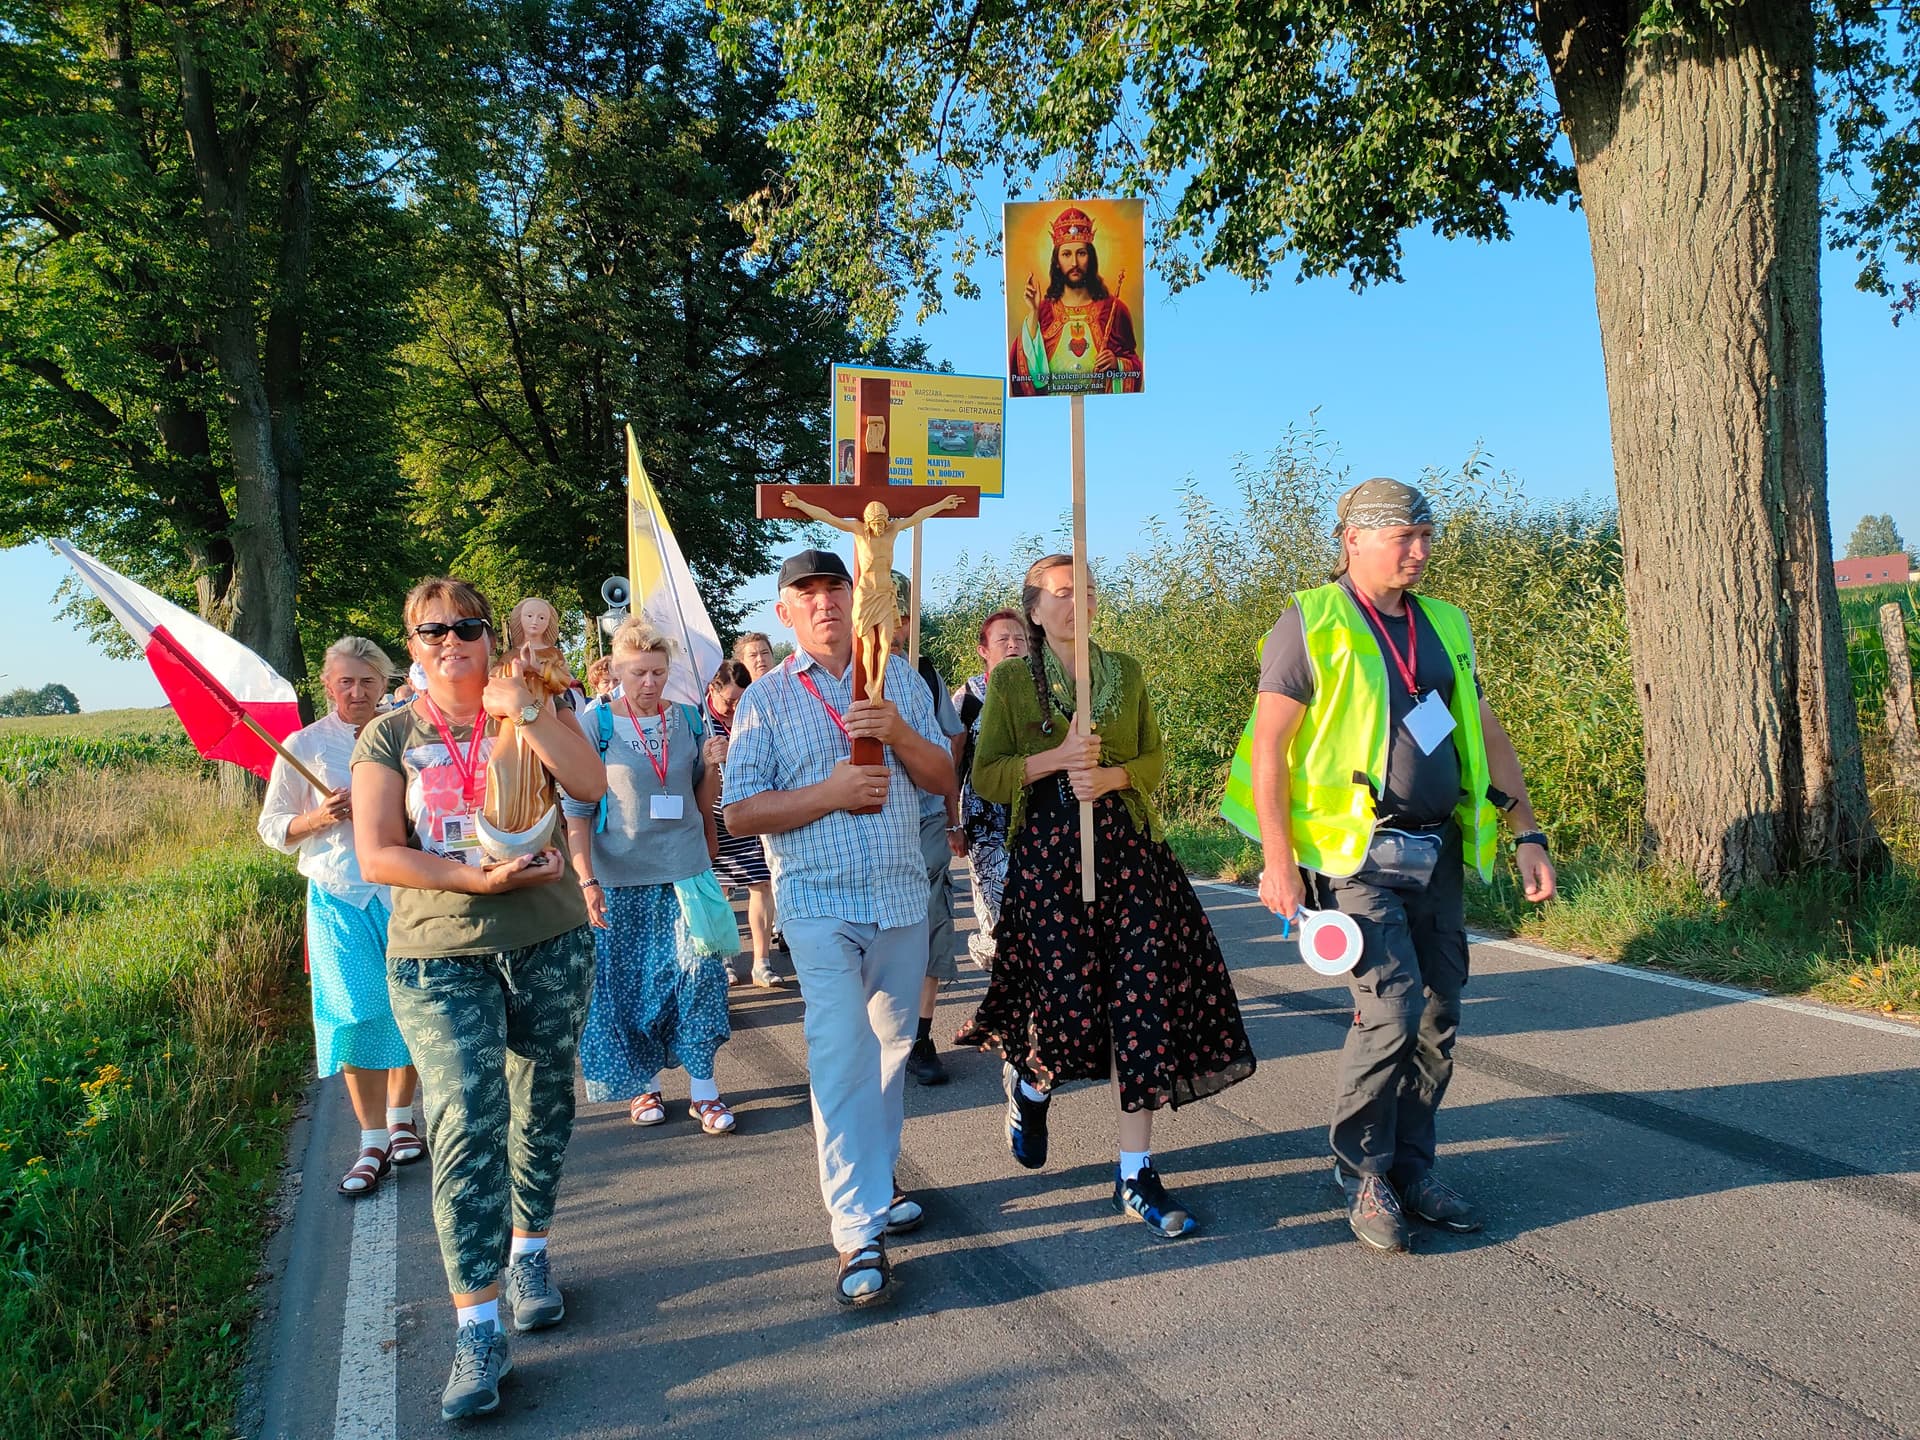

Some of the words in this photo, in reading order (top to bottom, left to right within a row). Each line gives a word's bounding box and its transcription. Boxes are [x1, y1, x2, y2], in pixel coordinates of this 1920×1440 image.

[1106, 370, 1141, 379] Ojczyzny
[927, 458, 951, 468] MARYJA
[889, 467, 913, 476] ADZIEJA
[927, 469, 936, 478] NA
[938, 470, 965, 479] RODZINY
